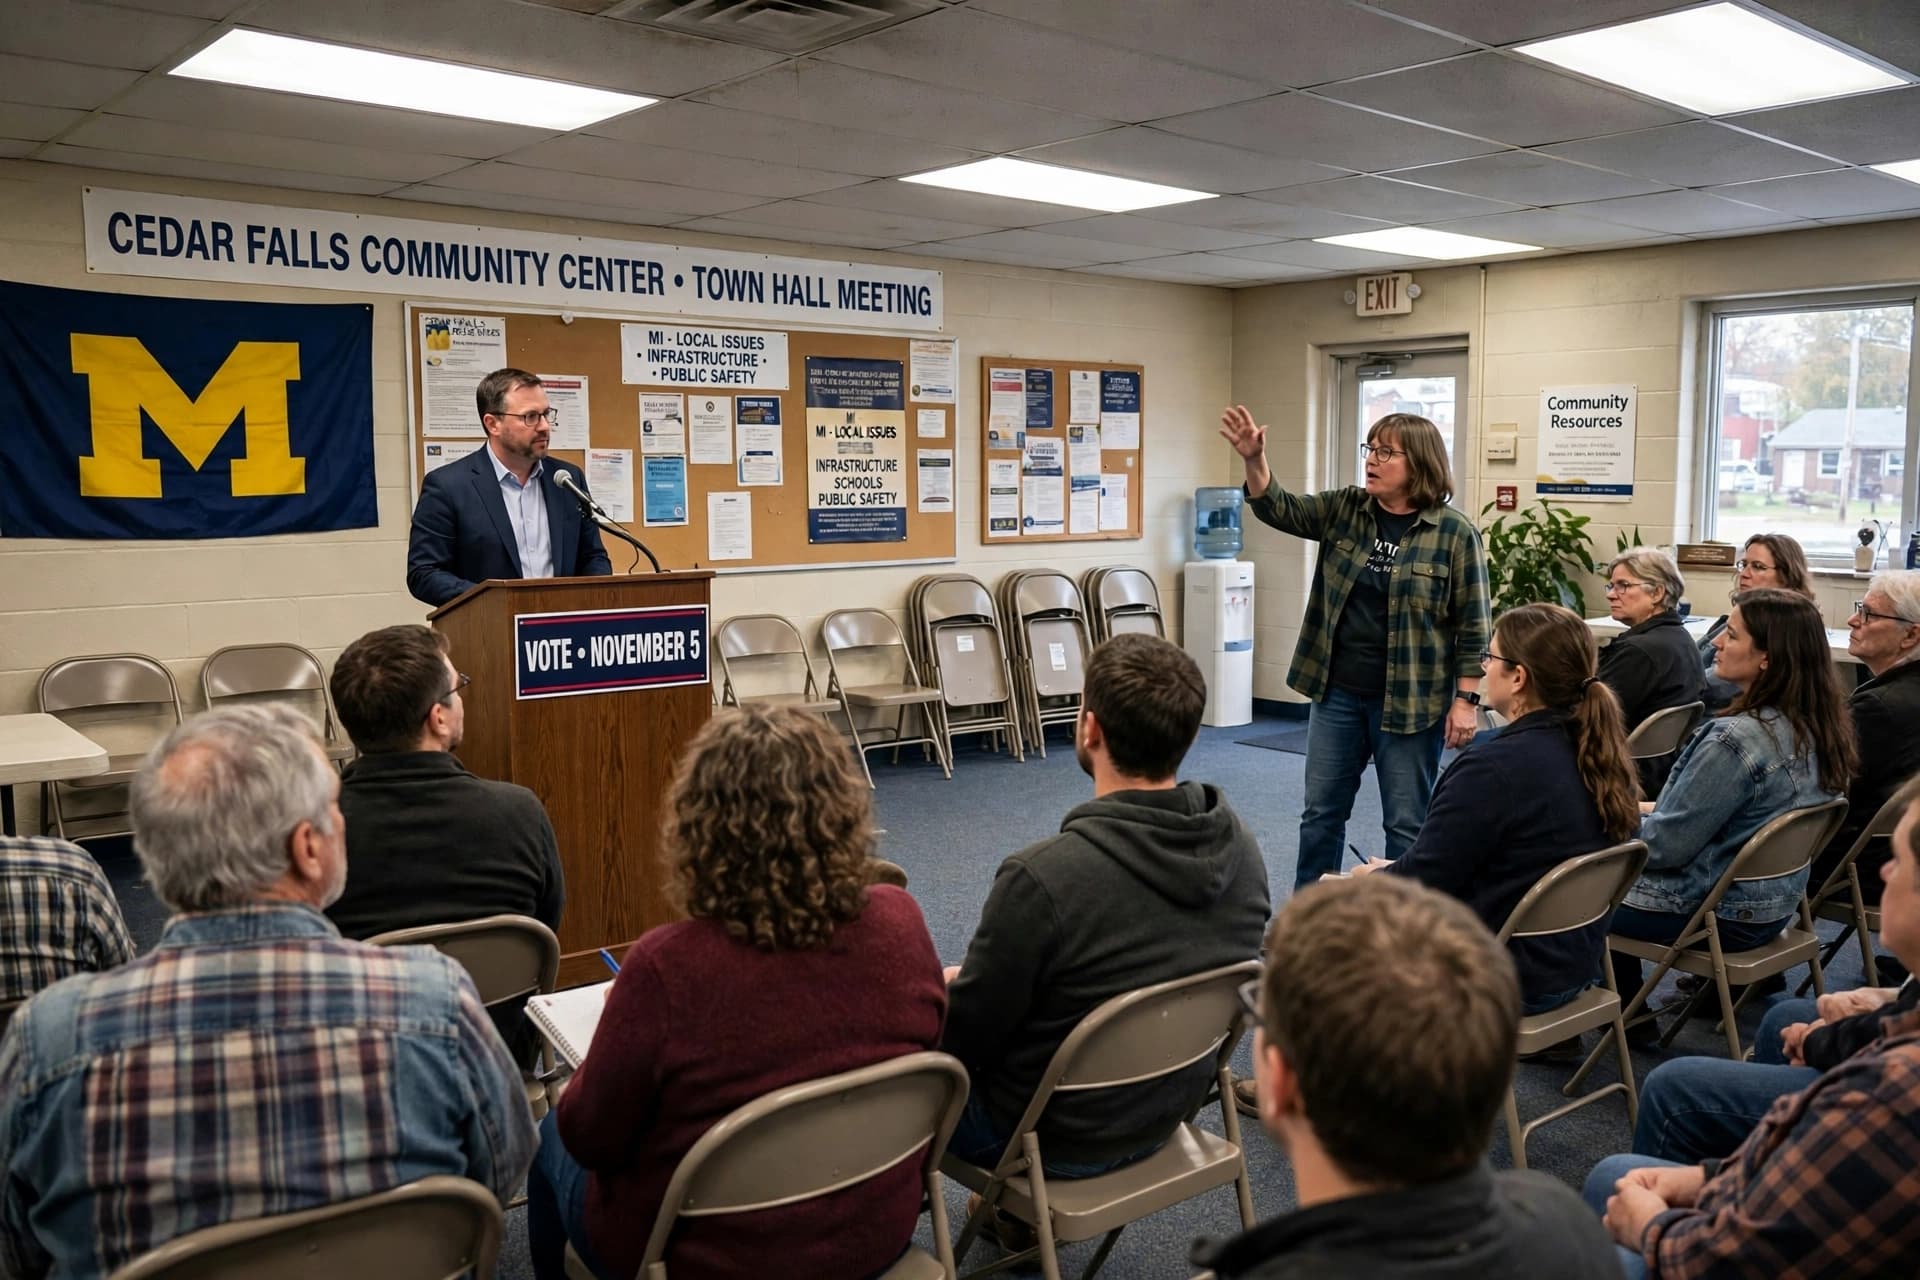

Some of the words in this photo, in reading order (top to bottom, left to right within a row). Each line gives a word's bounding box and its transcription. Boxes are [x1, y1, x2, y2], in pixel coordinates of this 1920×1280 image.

[108, 211, 236, 263] CEDAR
[246, 224, 350, 272] FALLS
[360, 235, 550, 287] COMMUNITY
[558, 253, 665, 296] CENTER
[692, 265, 764, 304] TOWN
[772, 272, 831, 309] HALL
[838, 278, 932, 317] MEETING
[1365, 276, 1400, 311] EXIT
[648, 330, 664, 345] MI
[676, 332, 718, 348] LOCAL
[721, 334, 765, 350] ISSUES
[647, 348, 759, 367] INFRASTRUCTURE
[661, 367, 707, 383] PUBLIC
[710, 369, 757, 384] SAFETY
[1547, 394, 1629, 412] Community
[70, 333, 305, 497] M
[1551, 414, 1623, 429] Resources
[815, 425, 826, 438] MI
[835, 425, 865, 439] LOCAL
[866, 426, 897, 439] ISSUES
[815, 459, 898, 472] INFRASTRUCTURE
[834, 477, 883, 489] SCHOOLS
[818, 493, 856, 506] PUBLIC
[860, 492, 897, 505] SAFETY
[524, 638, 573, 673] VOTE
[590, 630, 686, 668] NOVEMBER
[690, 629, 701, 660] 5
